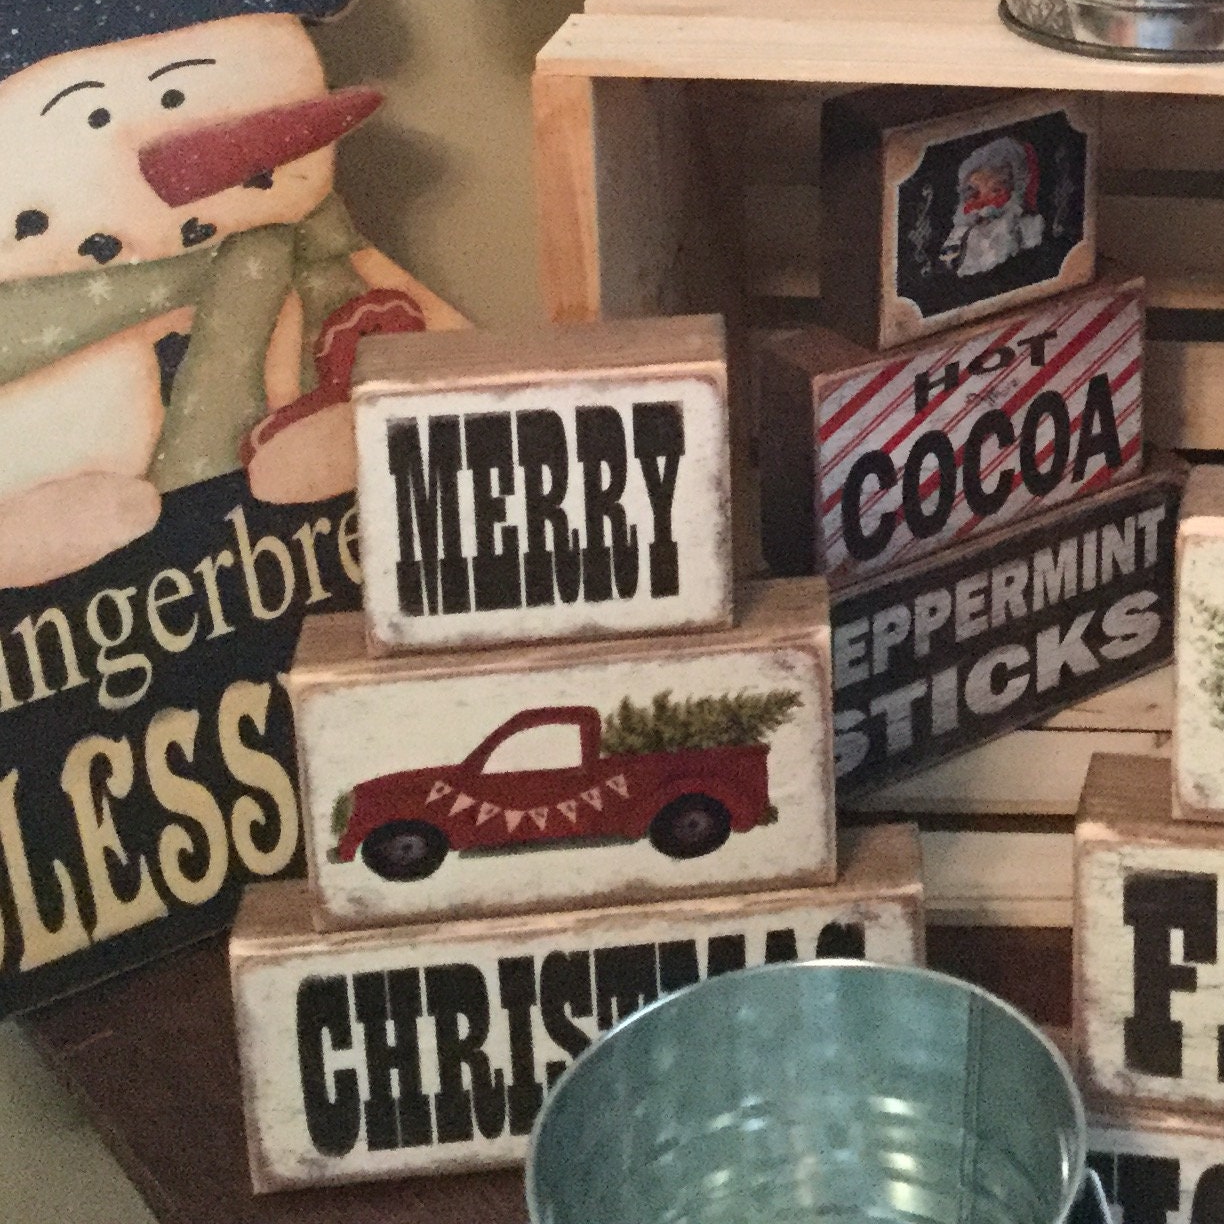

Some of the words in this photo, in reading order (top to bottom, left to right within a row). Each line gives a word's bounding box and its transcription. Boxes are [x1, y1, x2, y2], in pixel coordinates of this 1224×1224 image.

[841, 371, 1123, 562] COCOA
[914, 331, 1057, 414] HOT
[387, 400, 686, 618] MERRY
[834, 504, 1166, 689] EPPERMINT
[834, 589, 1162, 777] STICKS
[0, 680, 299, 972] LESS
